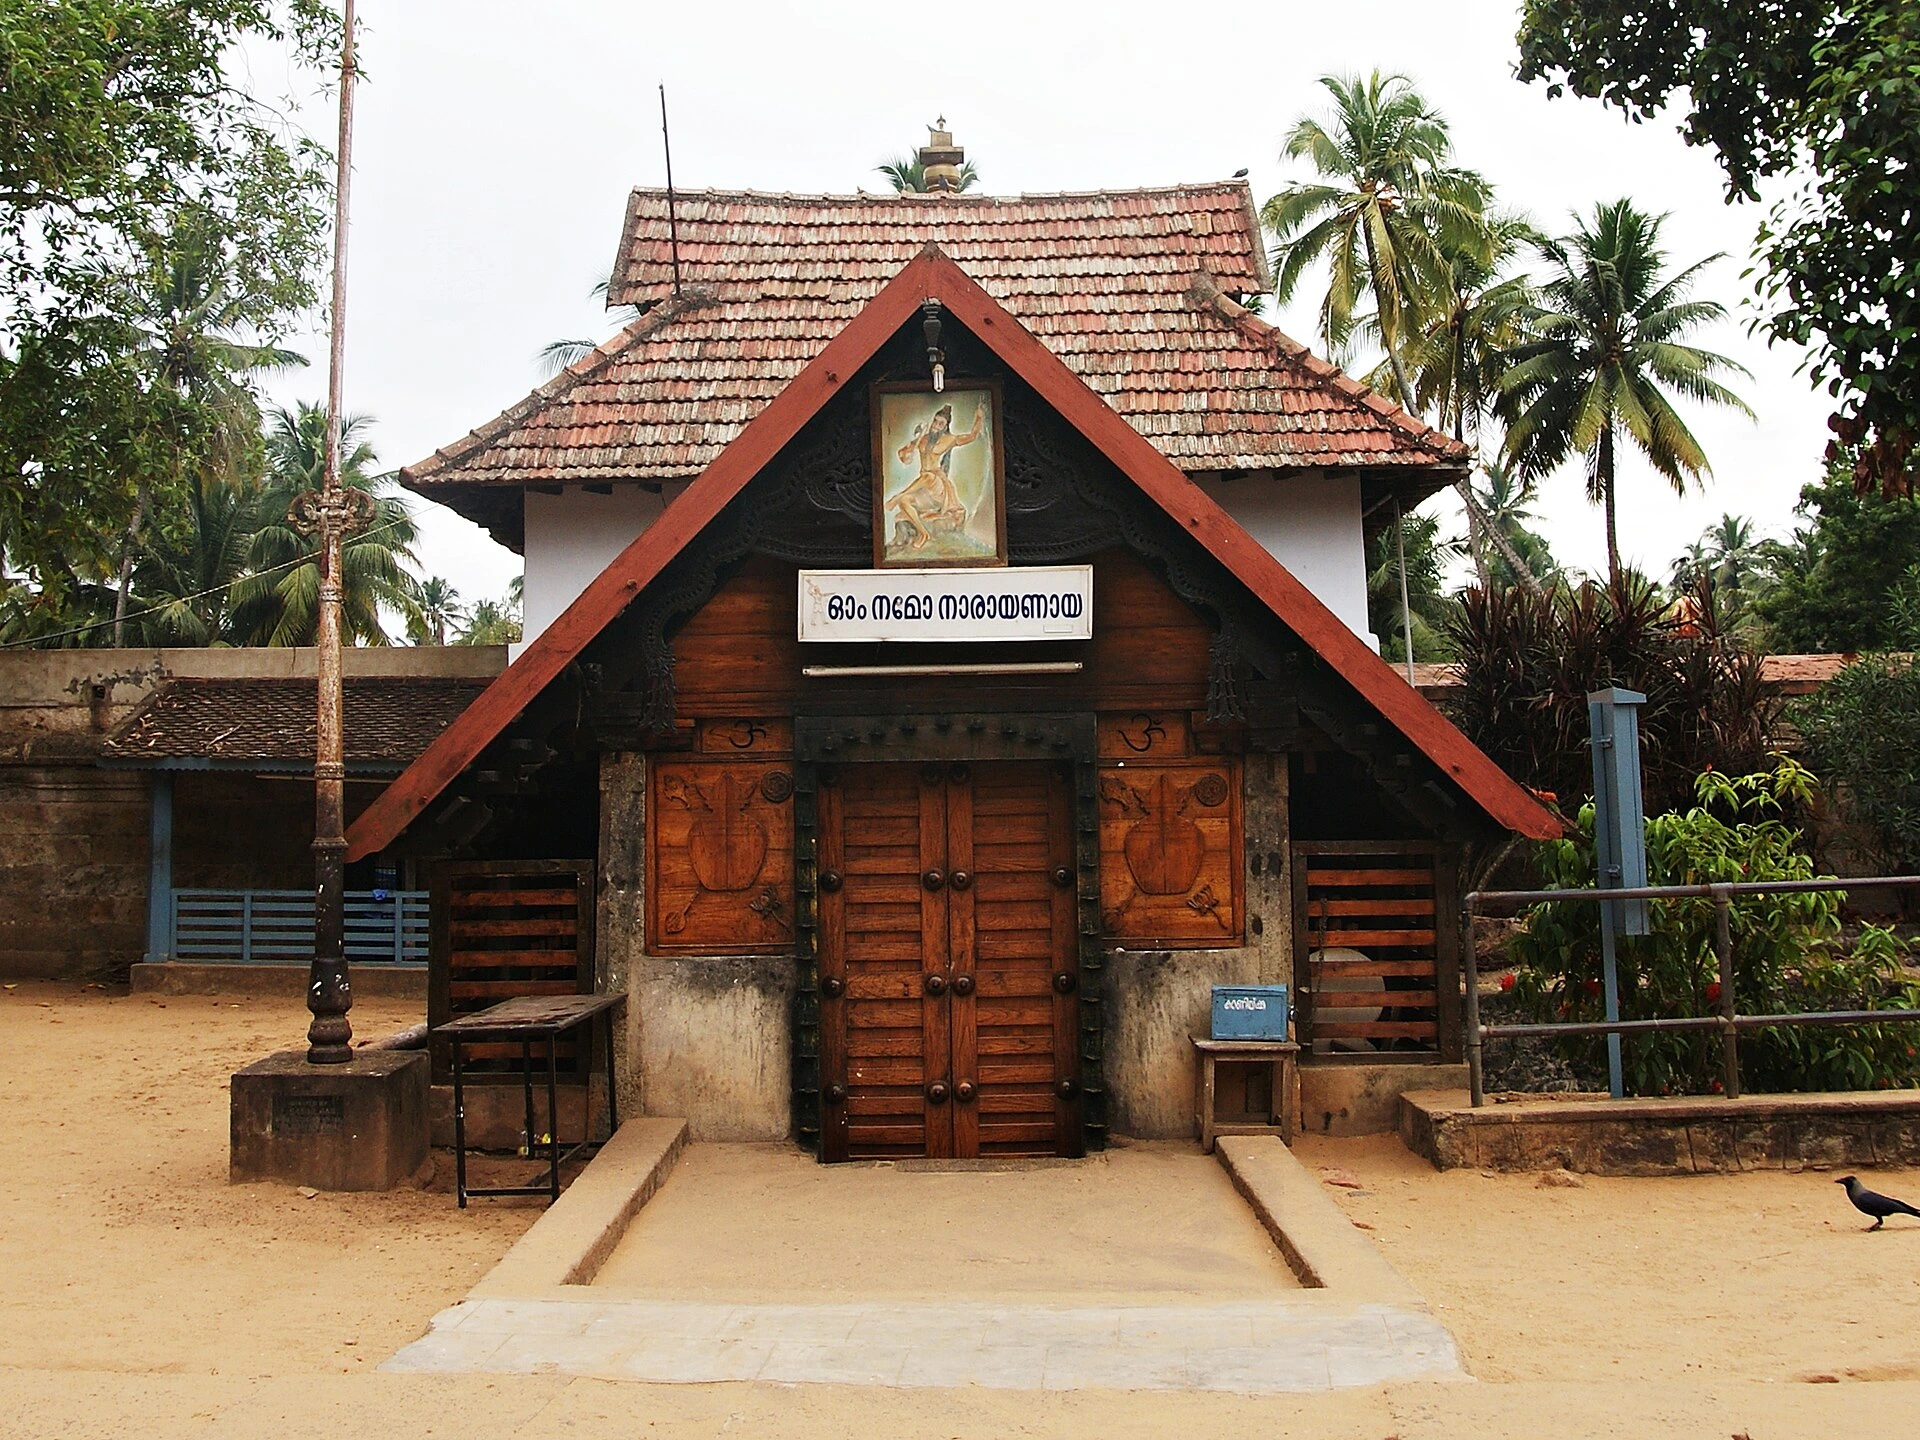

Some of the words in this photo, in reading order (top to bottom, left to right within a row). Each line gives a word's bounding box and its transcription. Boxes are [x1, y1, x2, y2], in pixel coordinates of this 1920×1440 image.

[828, 594, 867, 621] ഓം
[871, 594, 934, 621] നമോ
[938, 593, 1083, 621] നാരായണായ
